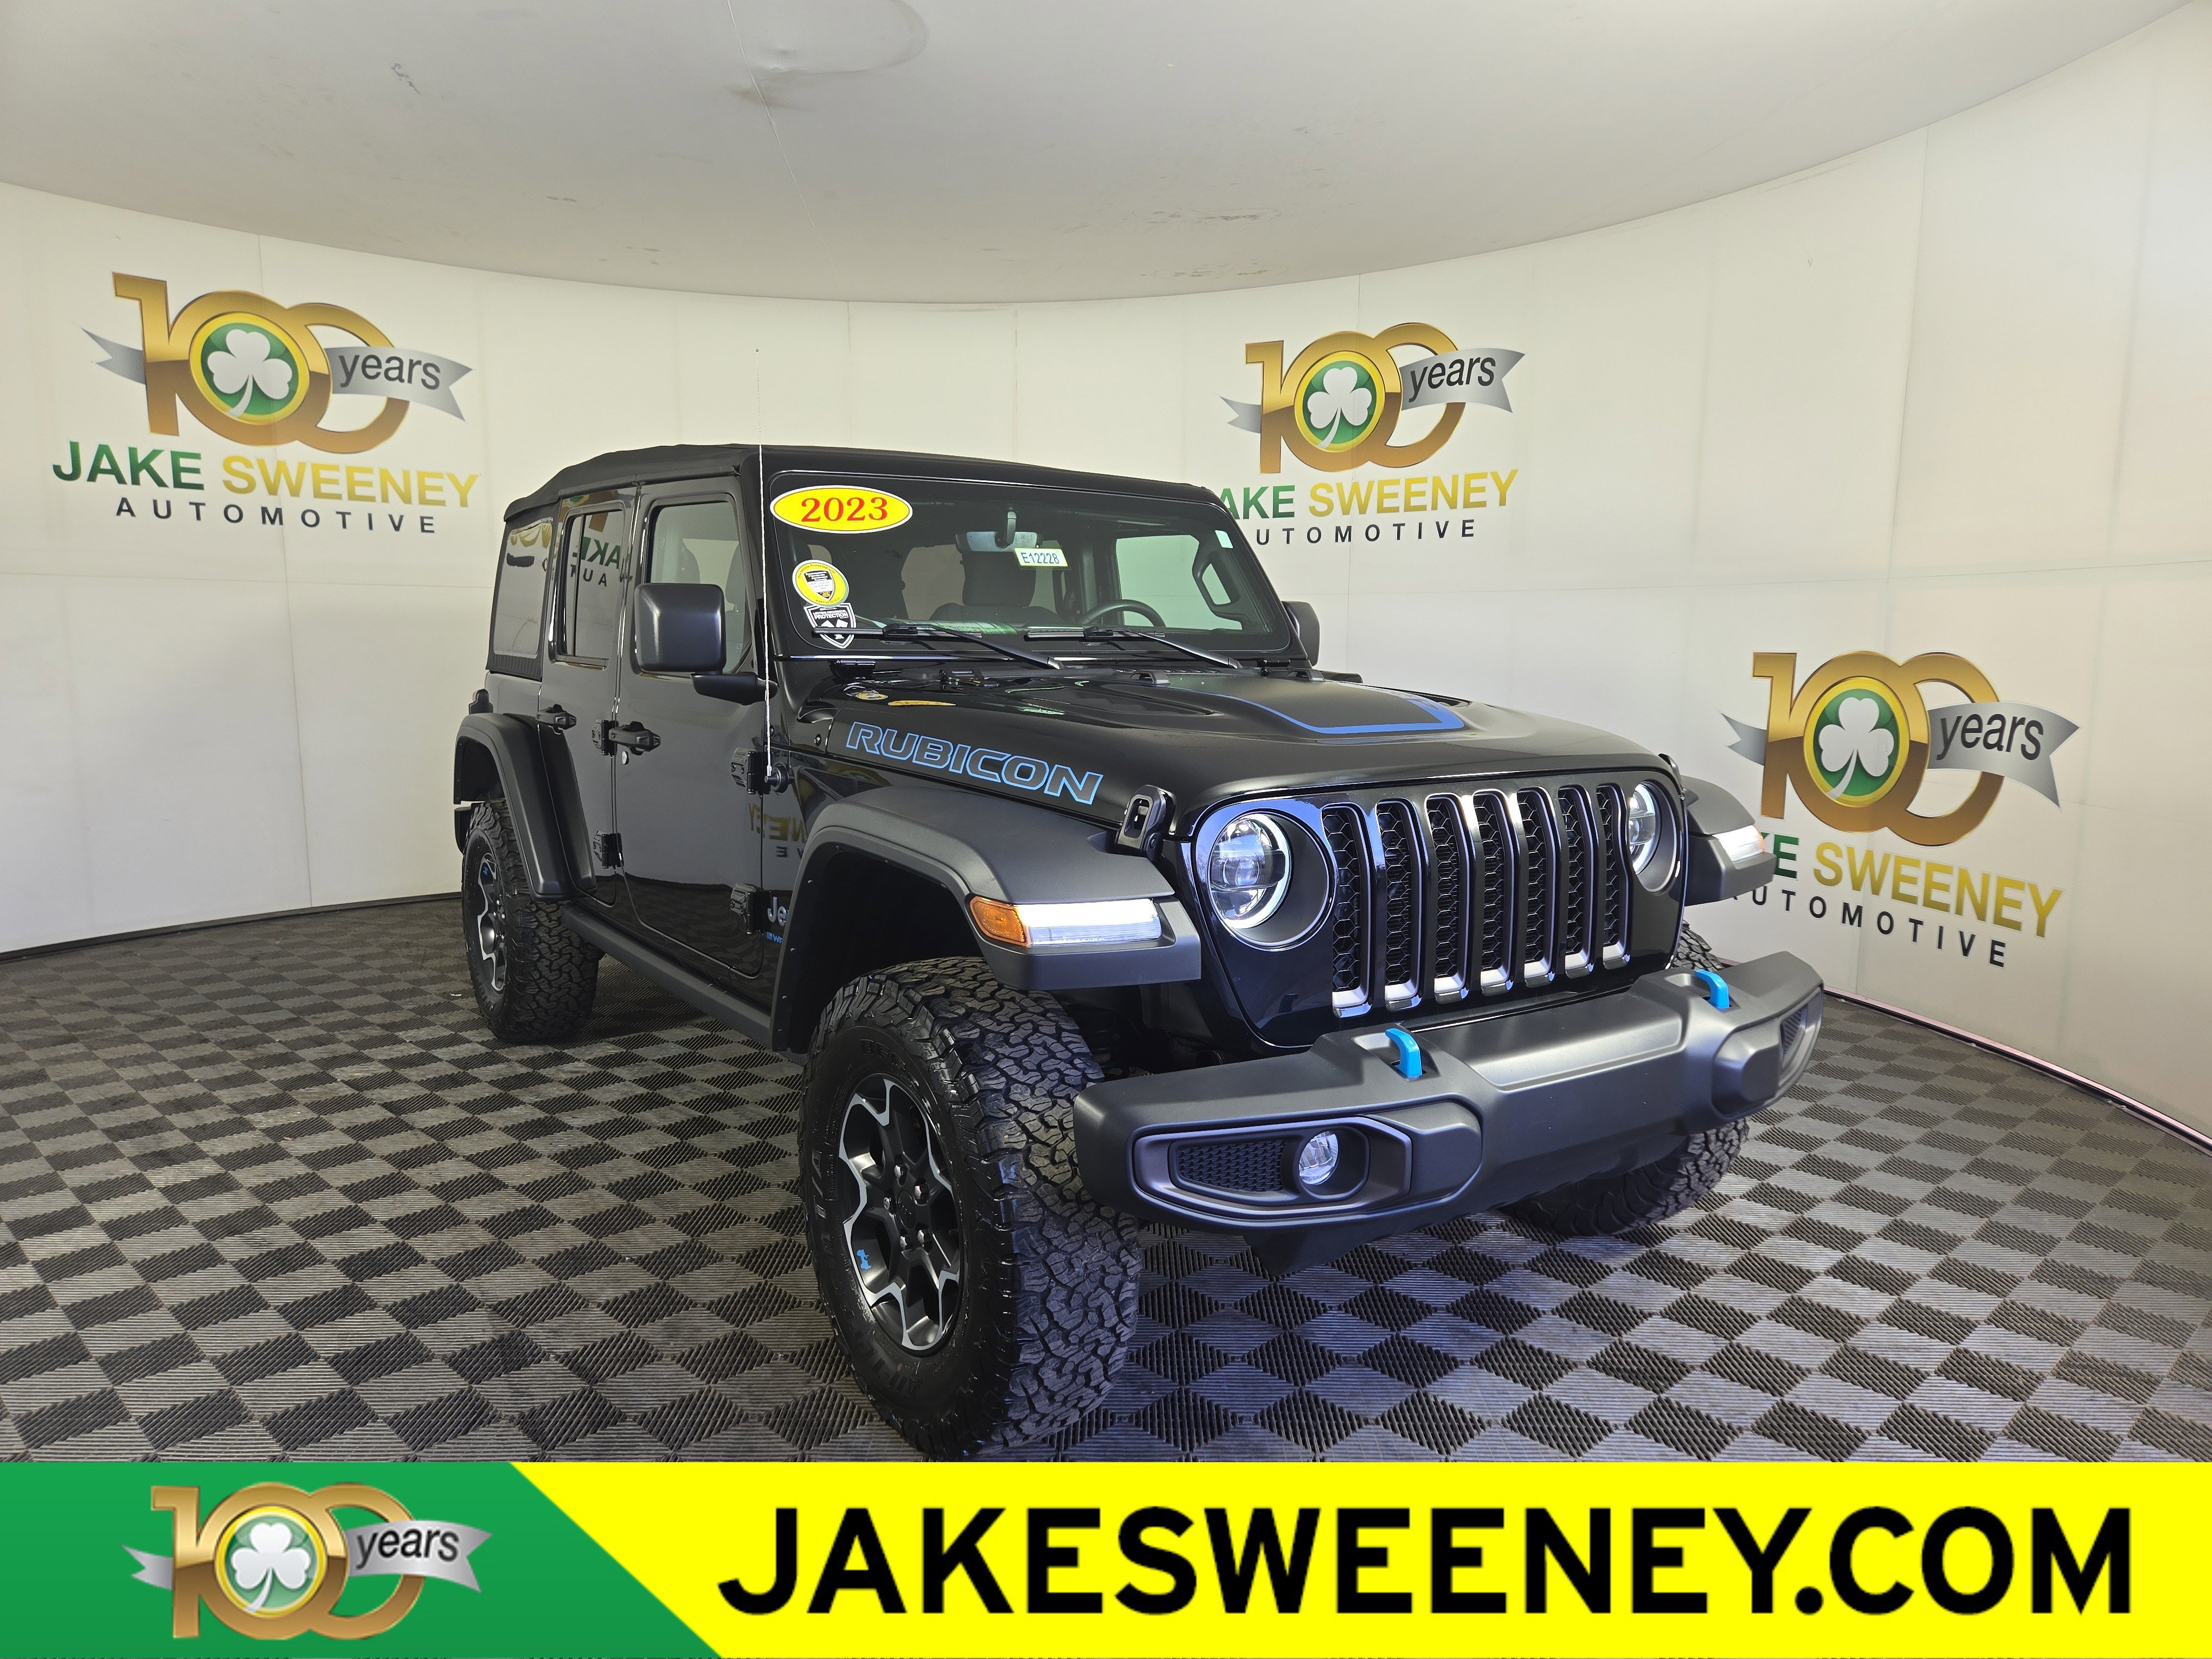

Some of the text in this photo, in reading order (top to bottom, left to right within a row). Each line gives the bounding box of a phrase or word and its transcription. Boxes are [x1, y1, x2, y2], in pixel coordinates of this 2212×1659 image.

[112, 272, 441, 454] 100 years
[1245, 322, 1496, 474] 100 years
[53, 440, 478, 507] JAKE SWEENEY
[1220, 469, 1519, 520] AKE SWEENEY
[115, 497, 435, 533] AUTOMOTIVE
[801, 497, 888, 522] 2023
[1257, 519, 1474, 545] UTOMOTIVE
[1021, 552, 1059, 564] E12228
[846, 722, 1103, 805] RUBICON
[1753, 651, 2044, 846] 100 years
[767, 897, 789, 926] Je
[1813, 841, 2063, 938] SWEENEY
[1750, 886, 2006, 967] UTOMOTIVE
